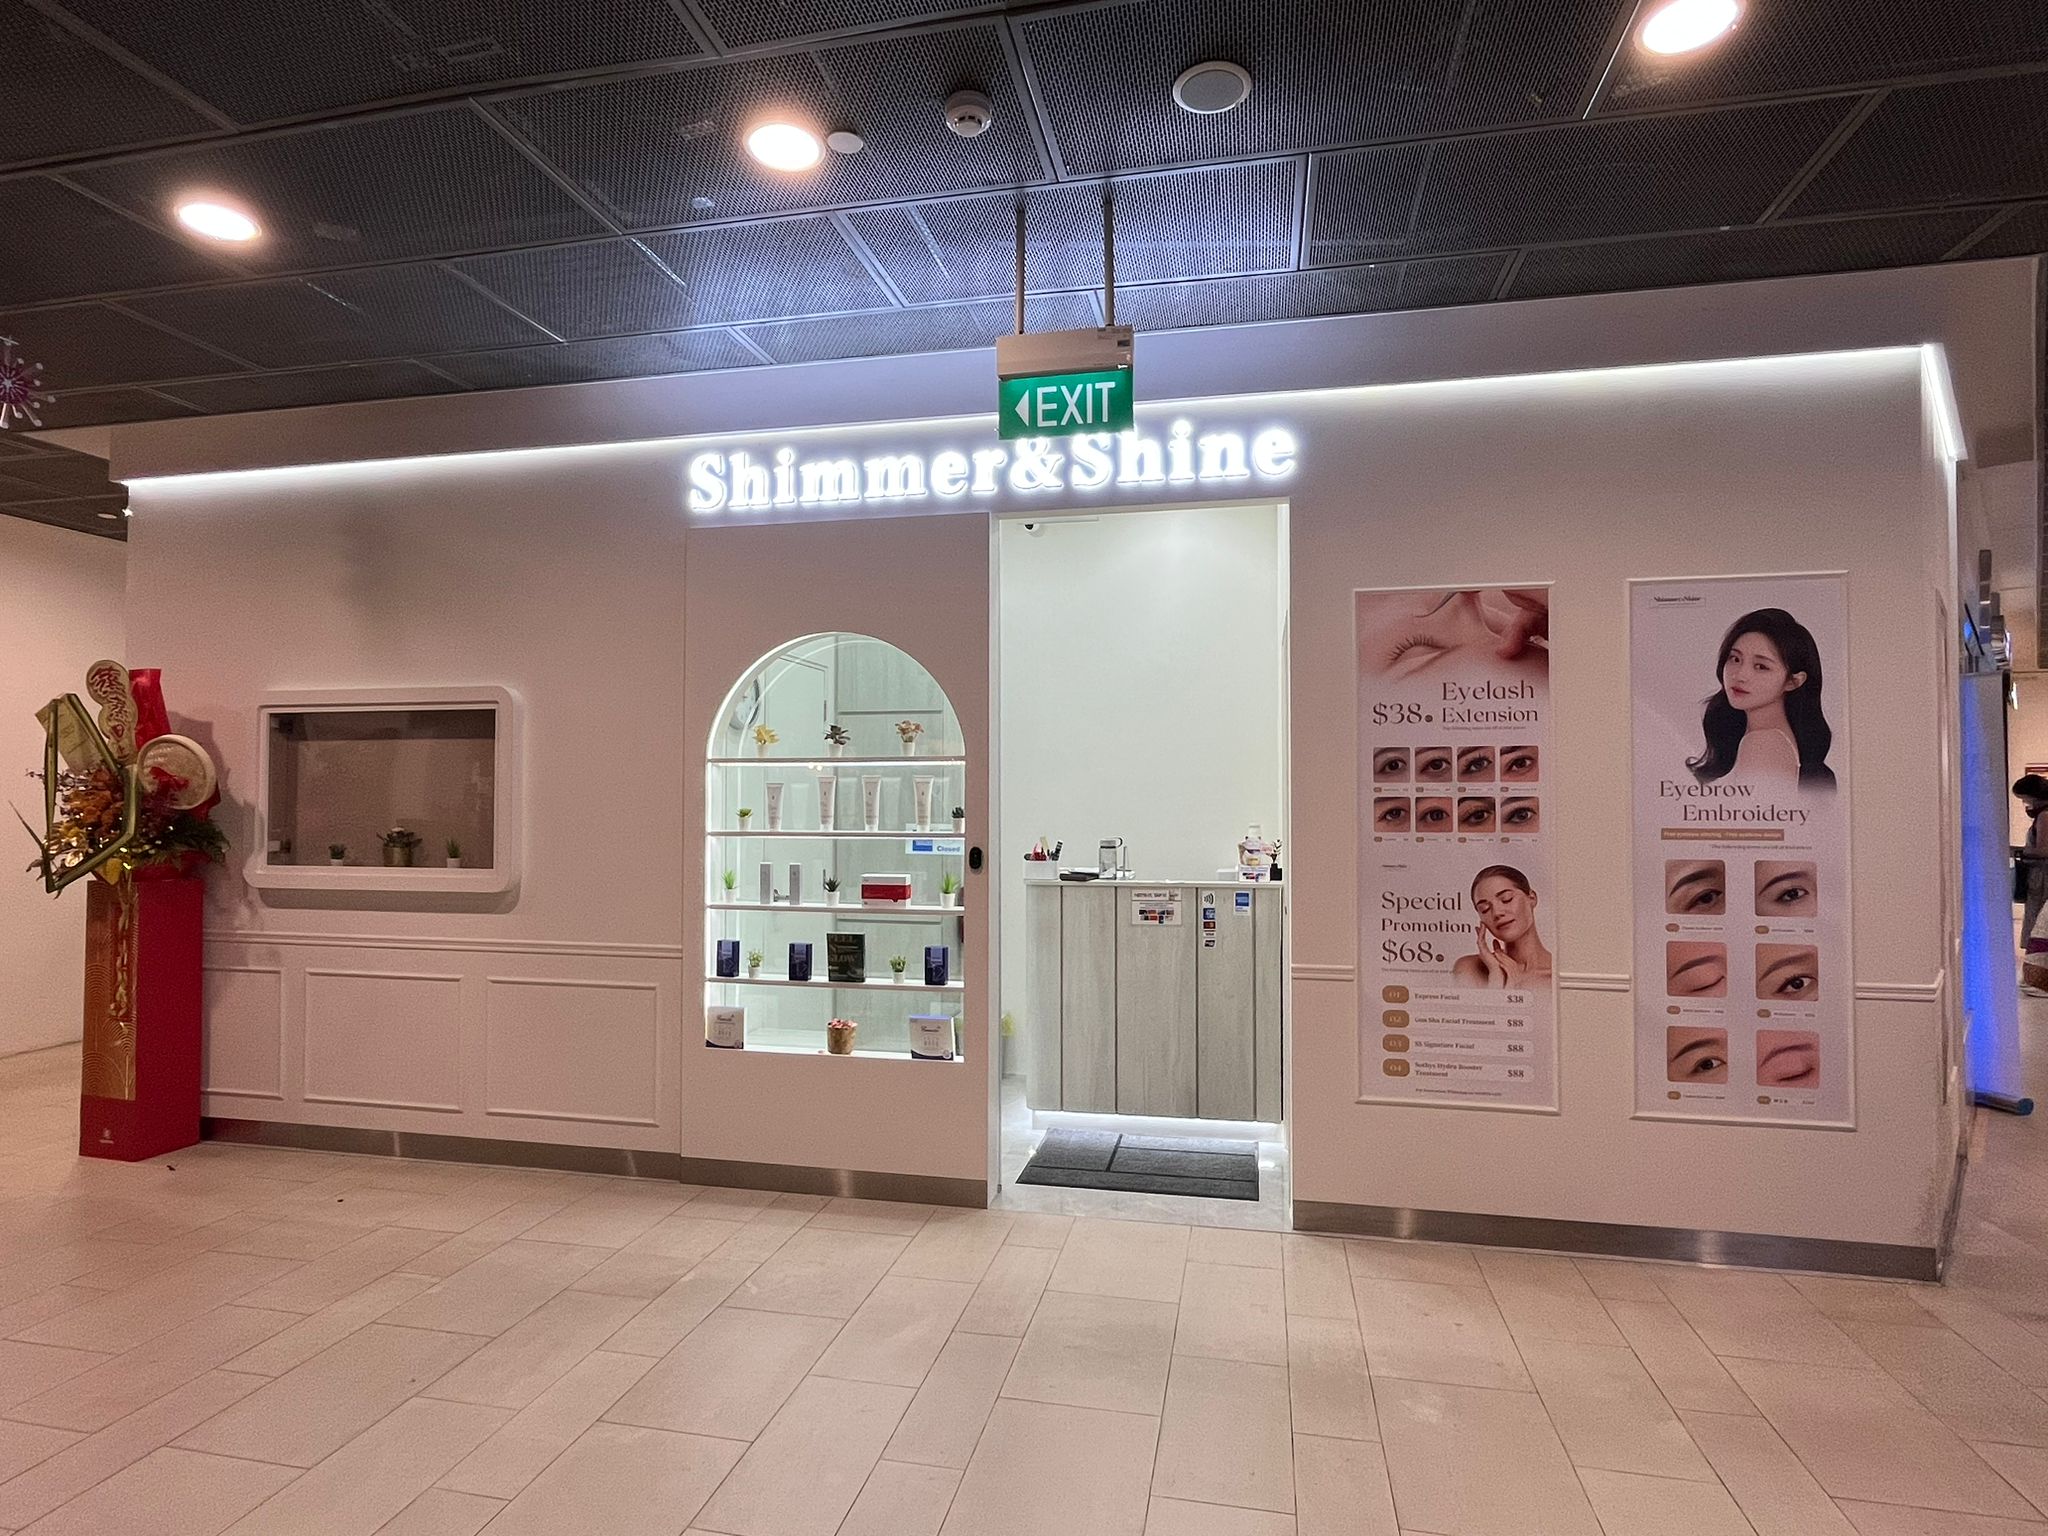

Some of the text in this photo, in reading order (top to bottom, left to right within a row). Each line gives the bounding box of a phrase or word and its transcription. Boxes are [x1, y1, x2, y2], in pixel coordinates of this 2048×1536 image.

[1036, 381, 1116, 428] EXIT
[1442, 680, 1535, 705] Eyelash
[1442, 705, 1539, 723] Extension
[1660, 779, 1756, 801] Eyebrow
[1682, 803, 1811, 826] Embroidery
[1381, 890, 1462, 913] Special
[1381, 917, 1472, 934] Promotion
[1506, 994, 1524, 1004] $38
[1506, 1018, 1524, 1028] $88
[1506, 1044, 1524, 1053] $88
[1507, 1069, 1524, 1078] $88
